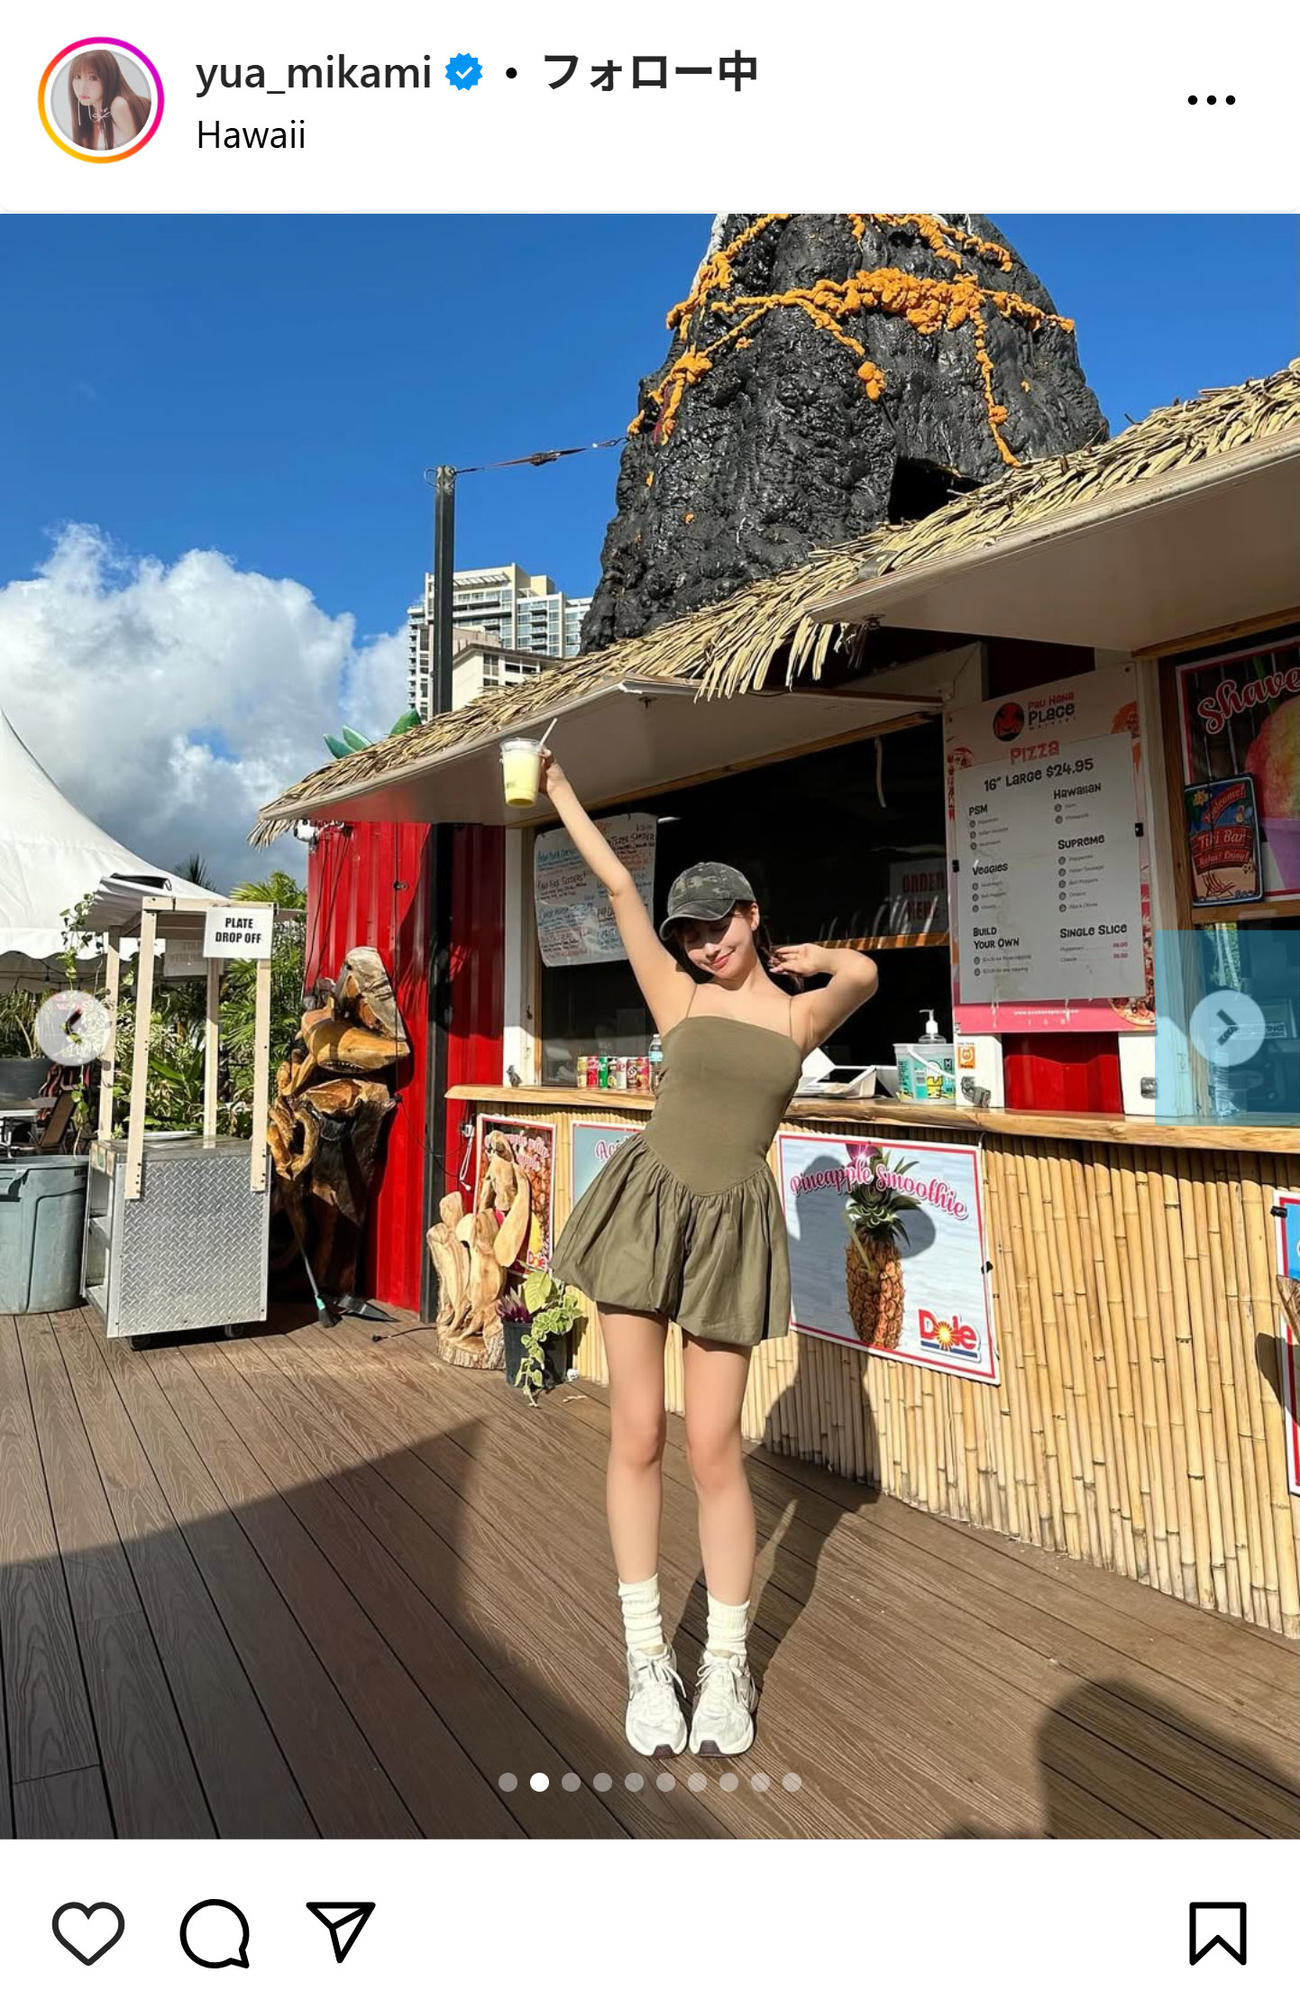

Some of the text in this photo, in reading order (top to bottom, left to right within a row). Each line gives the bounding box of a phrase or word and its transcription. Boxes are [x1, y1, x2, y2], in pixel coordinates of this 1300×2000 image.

[1198, 666, 1300, 735] Shave
[1046, 758, 1094, 779] $24.95
[968, 804, 988, 816] PSM
[1223, 830, 1246, 844] Bar
[225, 917, 254, 929] PLATE
[215, 931, 262, 944] DROP OFF
[789, 1159, 968, 1219] Pineapple Smoothie
[918, 1309, 978, 1351] Dole
